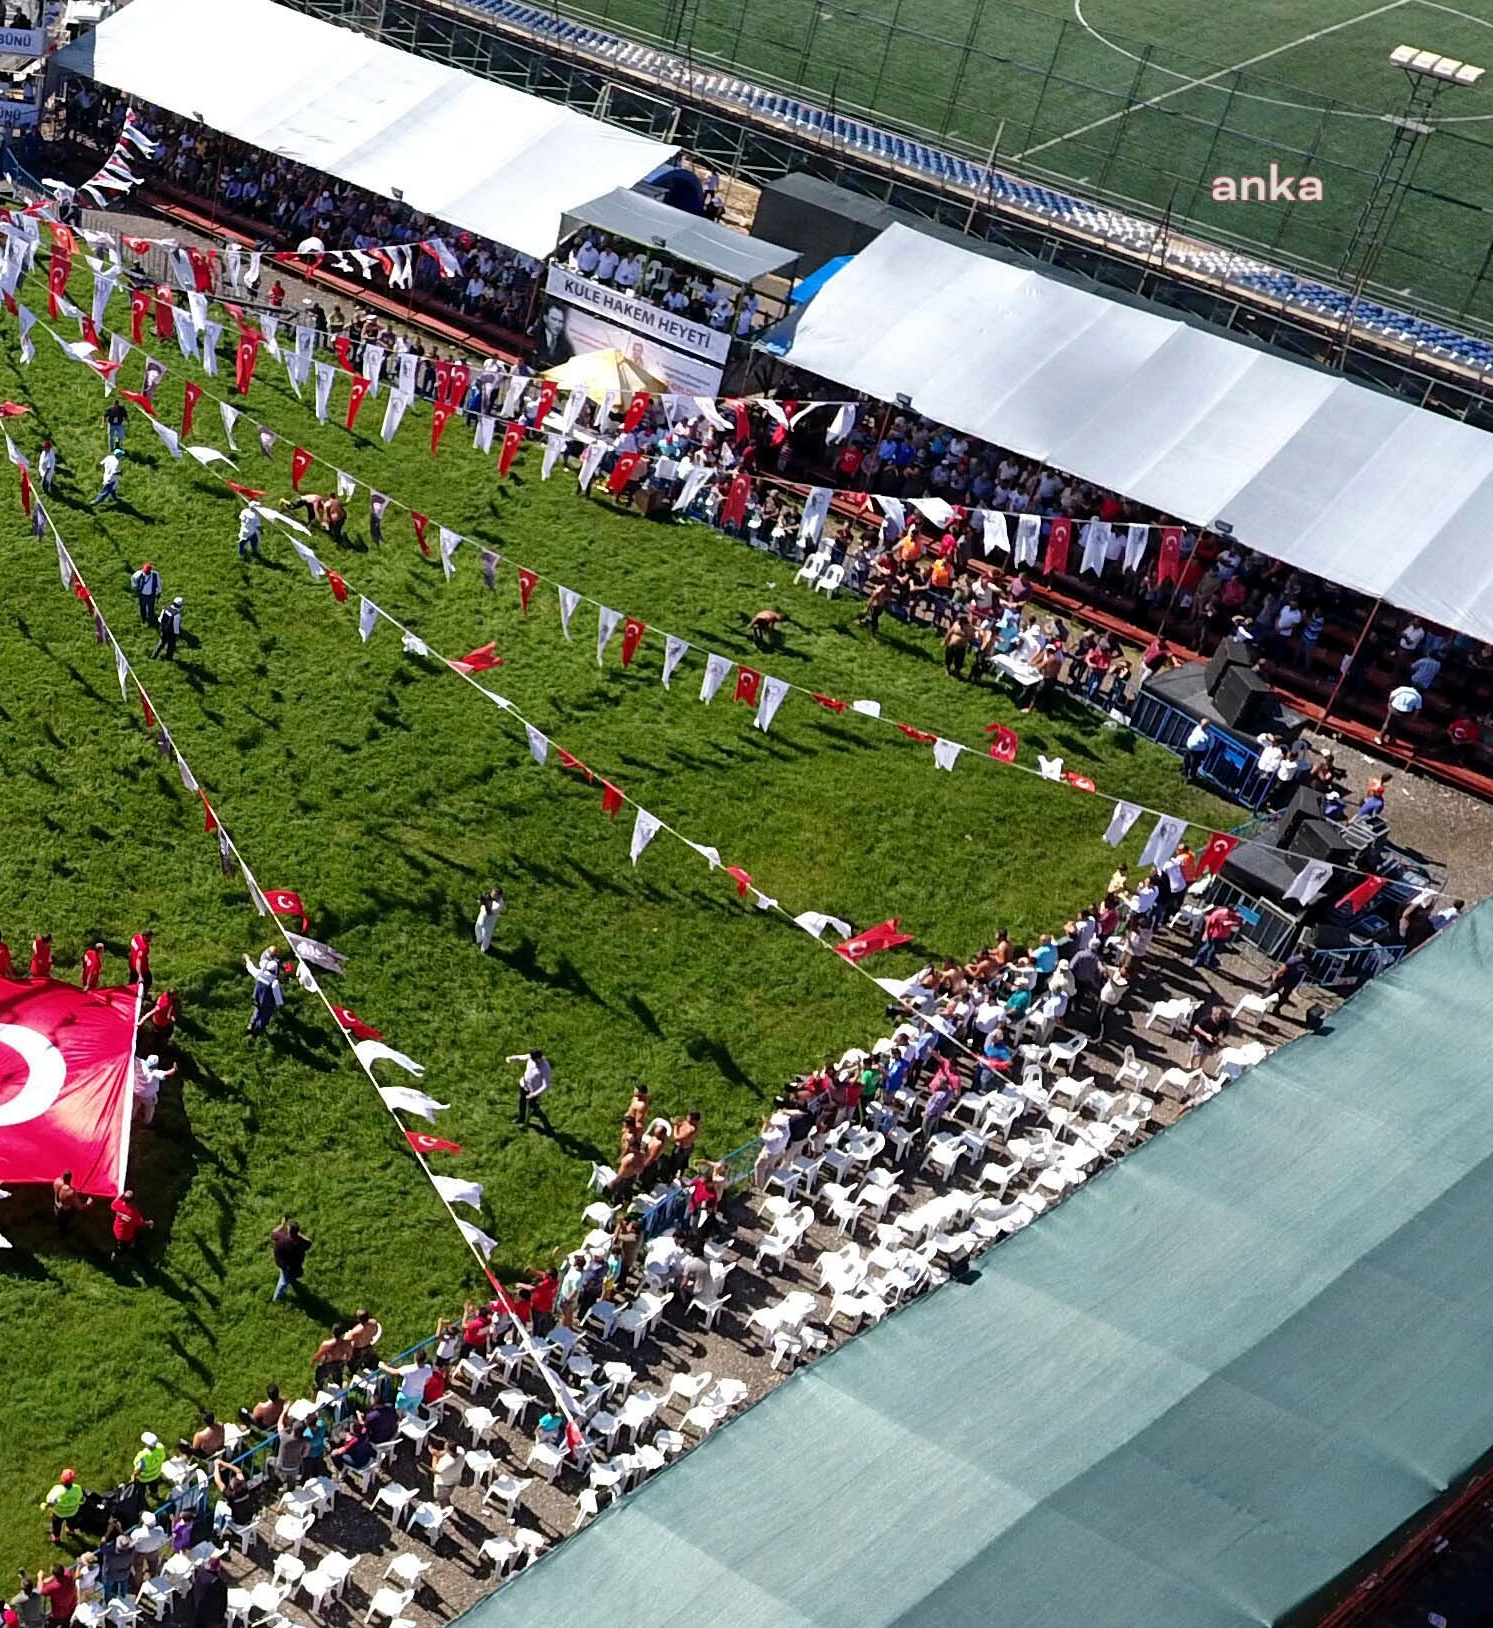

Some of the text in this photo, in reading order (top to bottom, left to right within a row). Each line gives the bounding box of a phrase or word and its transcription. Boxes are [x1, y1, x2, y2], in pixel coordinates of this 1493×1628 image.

[564, 279, 711, 348] KULE HAKEM HEYETİ
